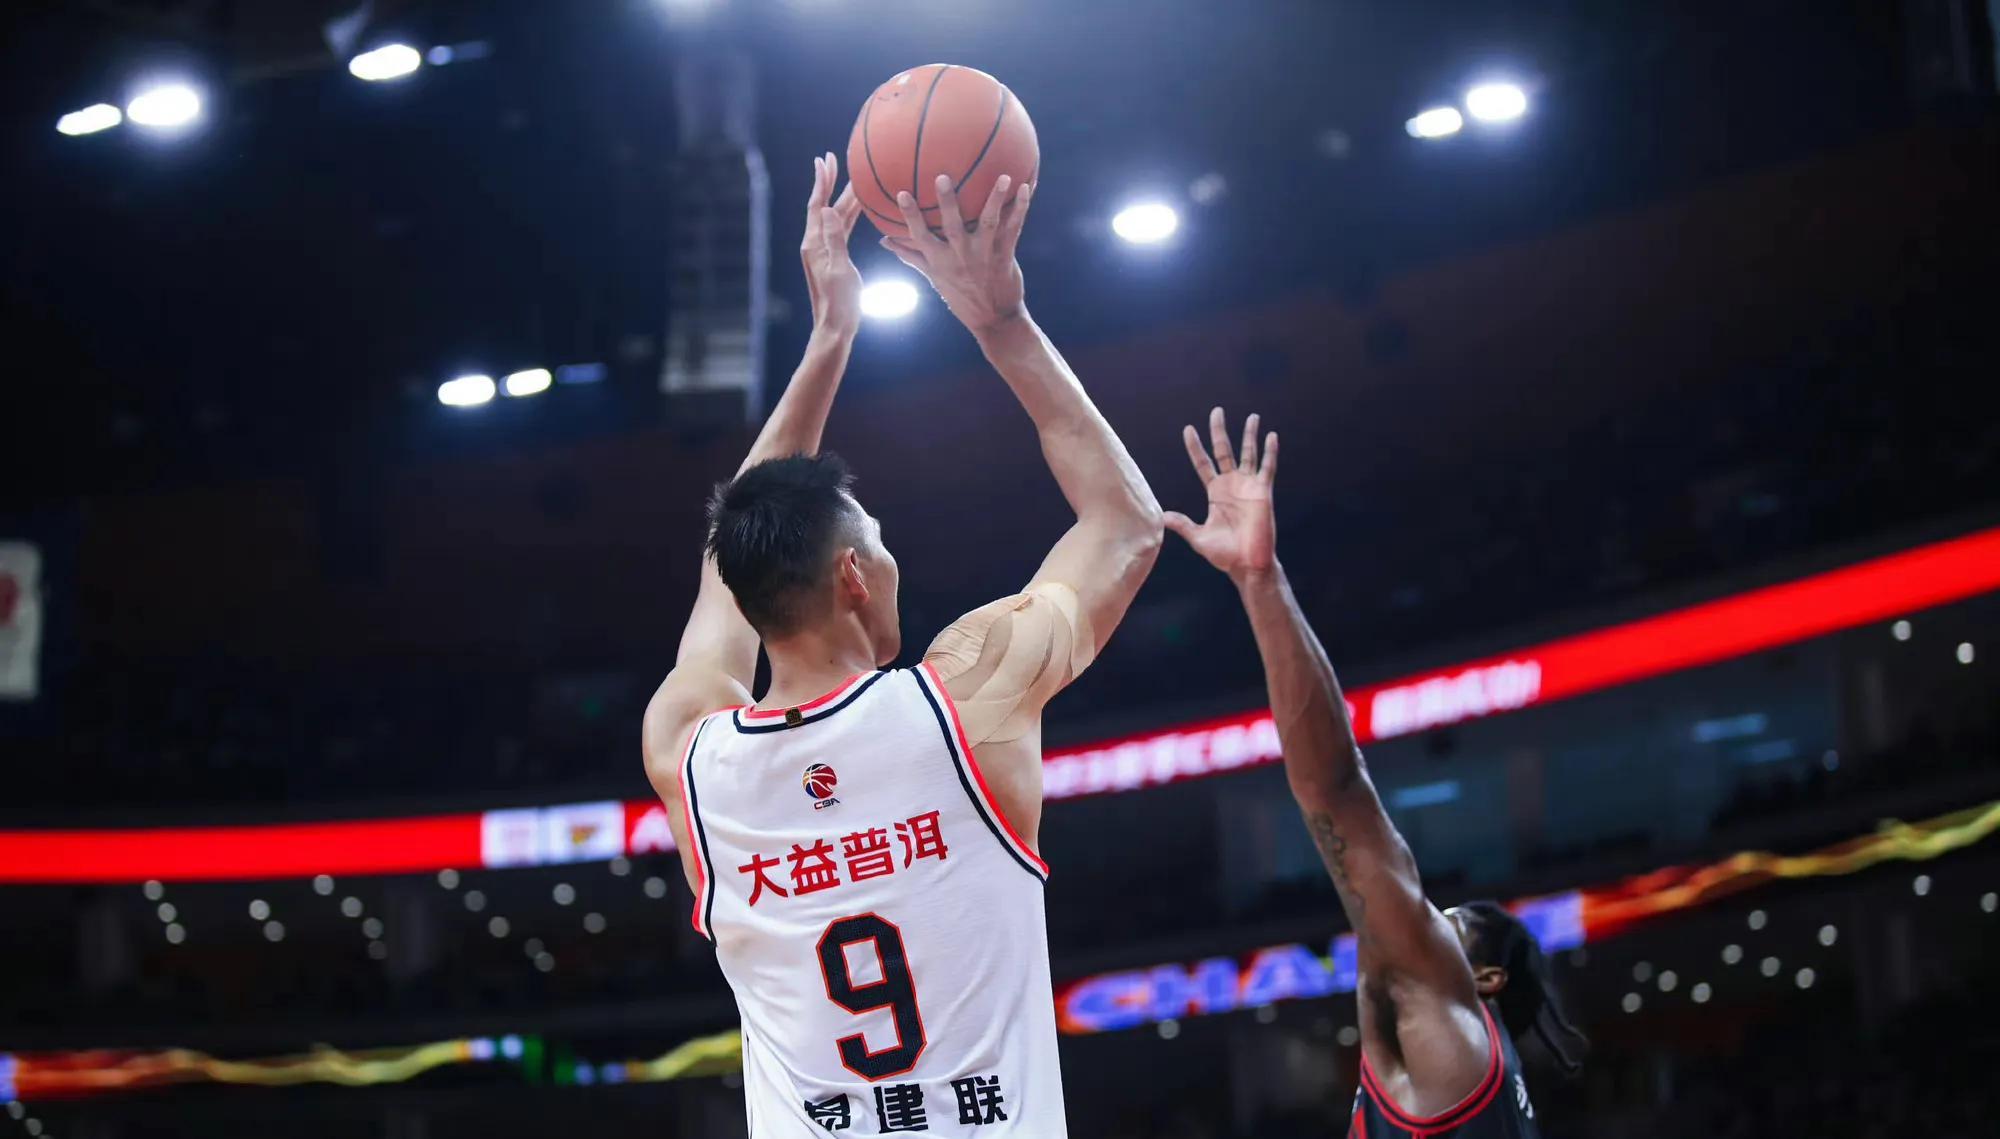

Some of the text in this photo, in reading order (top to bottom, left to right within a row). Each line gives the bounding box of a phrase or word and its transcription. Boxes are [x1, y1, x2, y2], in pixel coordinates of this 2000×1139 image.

[814, 798, 840, 810] CBA
[738, 810, 948, 907] 大益普洱
[816, 912, 927, 1082] 9
